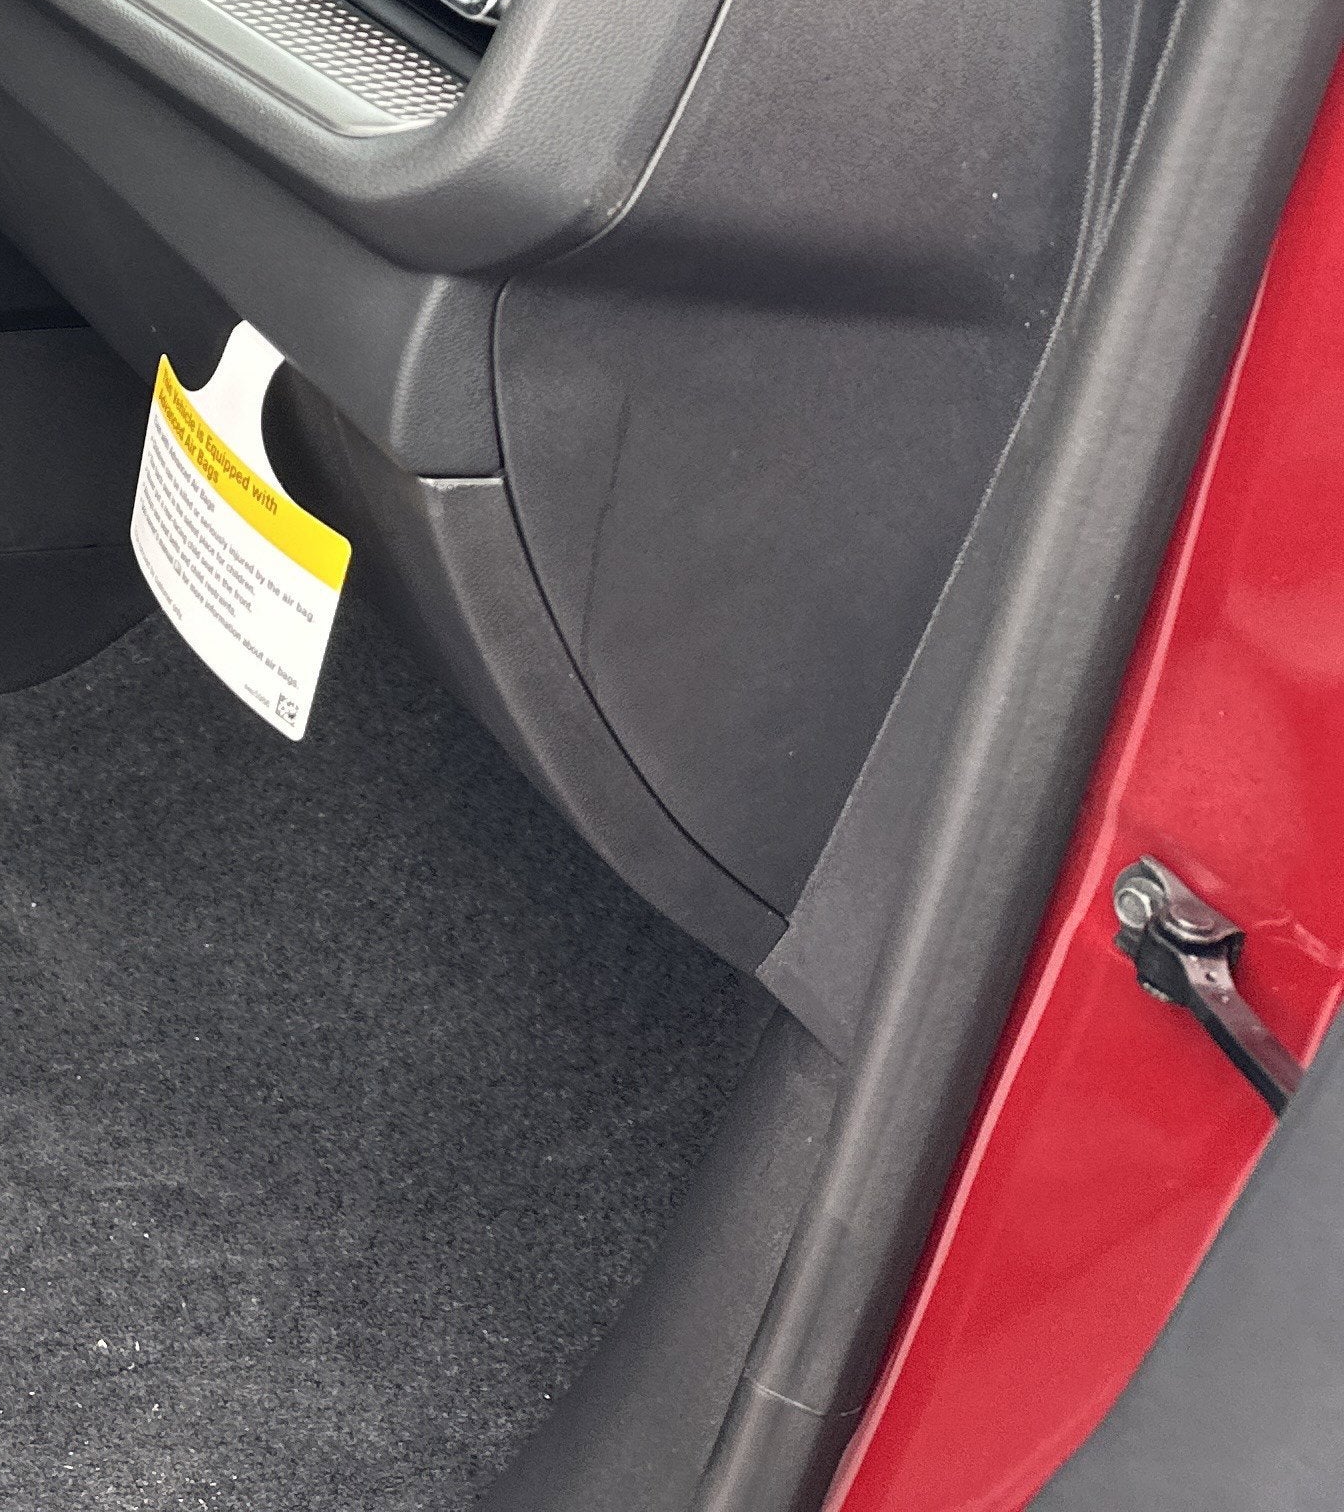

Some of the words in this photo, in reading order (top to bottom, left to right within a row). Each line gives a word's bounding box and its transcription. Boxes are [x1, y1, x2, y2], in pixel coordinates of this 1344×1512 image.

[184, 433, 197, 456] Air
[196, 448, 219, 484] Bags
[204, 434, 251, 491] Equipped
[252, 484, 278, 515] with
[199, 488, 215, 513] Bags
[200, 515, 228, 551] seriously
[228, 546, 255, 575] injured
[266, 579, 281, 597] the
[281, 592, 295, 606] air
[225, 563, 255, 596] children.
[204, 600, 242, 641] information
[242, 638, 264, 661] about
[264, 657, 276, 670] air
